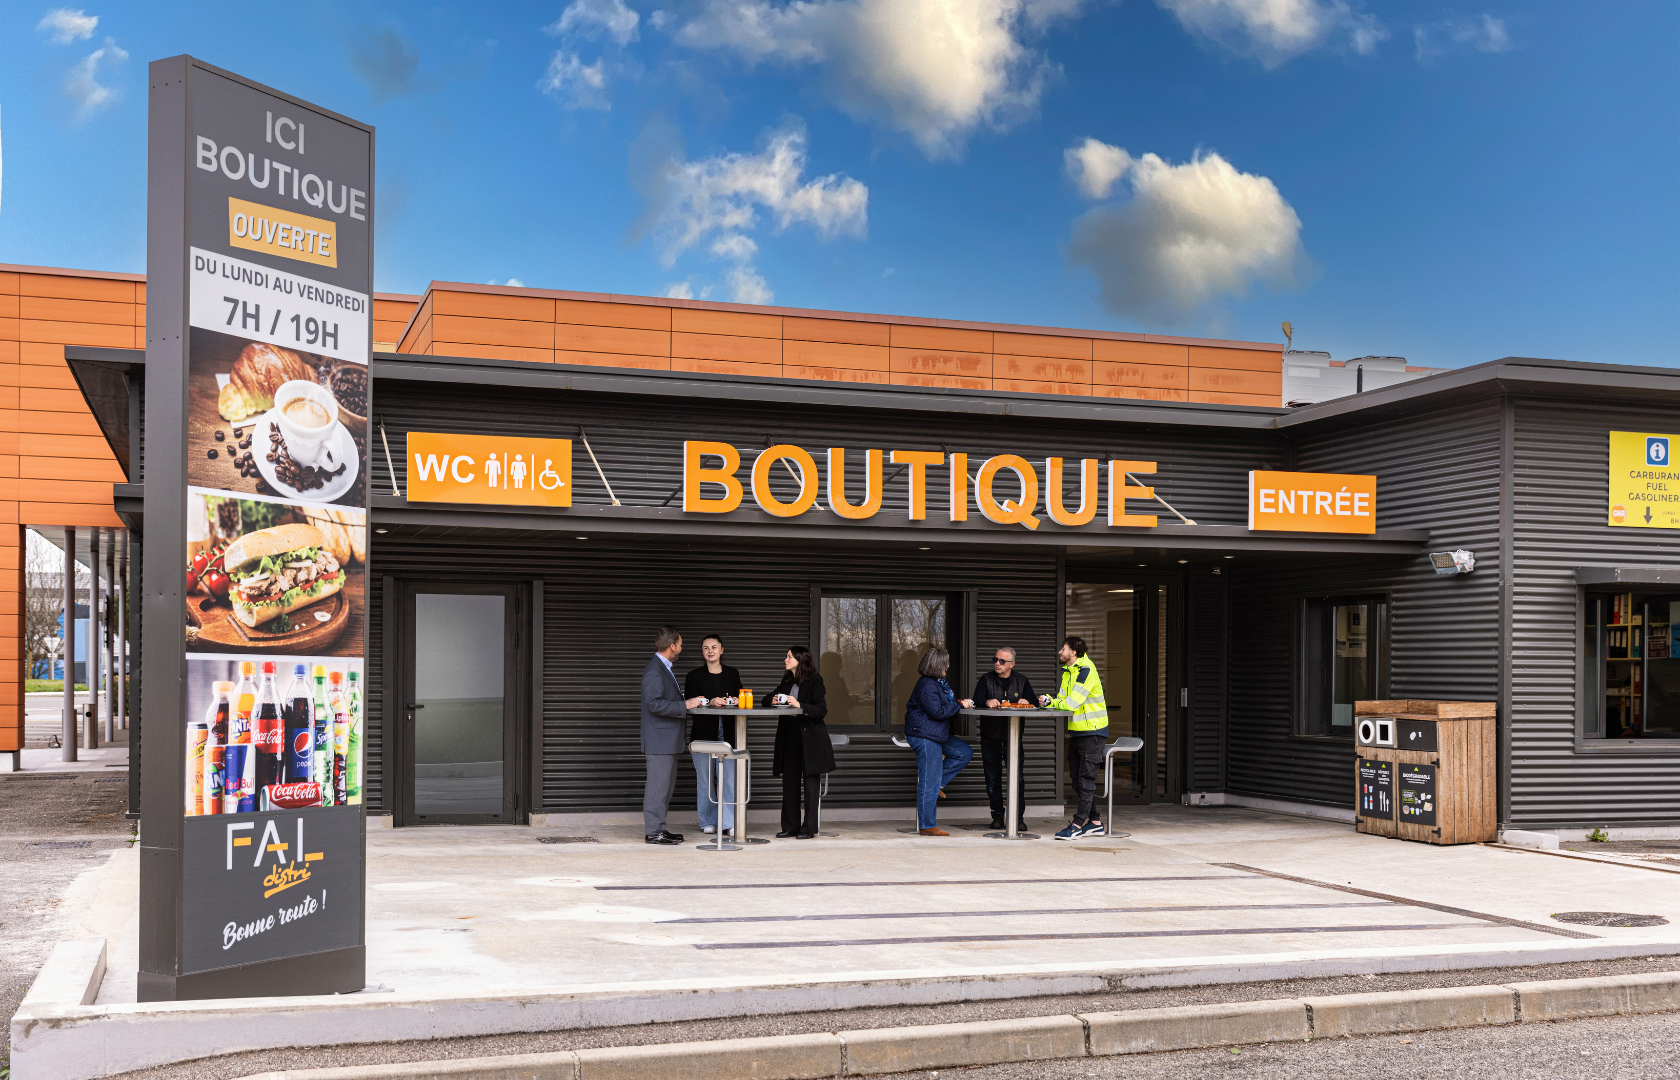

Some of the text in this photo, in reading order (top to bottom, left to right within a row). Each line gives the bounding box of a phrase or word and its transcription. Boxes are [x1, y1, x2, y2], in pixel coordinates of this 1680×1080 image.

[266, 111, 304, 155] ICI
[196, 134, 366, 222] BOUTIQUE
[233, 212, 331, 257] OUVERTE
[195, 255, 365, 314] DU LUNDI AU VENDREDI
[223, 296, 260, 333] 7H
[290, 313, 339, 350] 19H
[415, 453, 475, 484] WC
[683, 440, 1157, 531] BOUTIQUE
[1646, 482, 1668, 491] FUEL
[1259, 487, 1370, 517] ENTRÉE
[1628, 492, 1680, 503] GASOLINER
[225, 777, 255, 790] Red Bull
[226, 817, 324, 870] FAL
[263, 860, 311, 890] distri
[222, 888, 327, 950] Bonne route !
